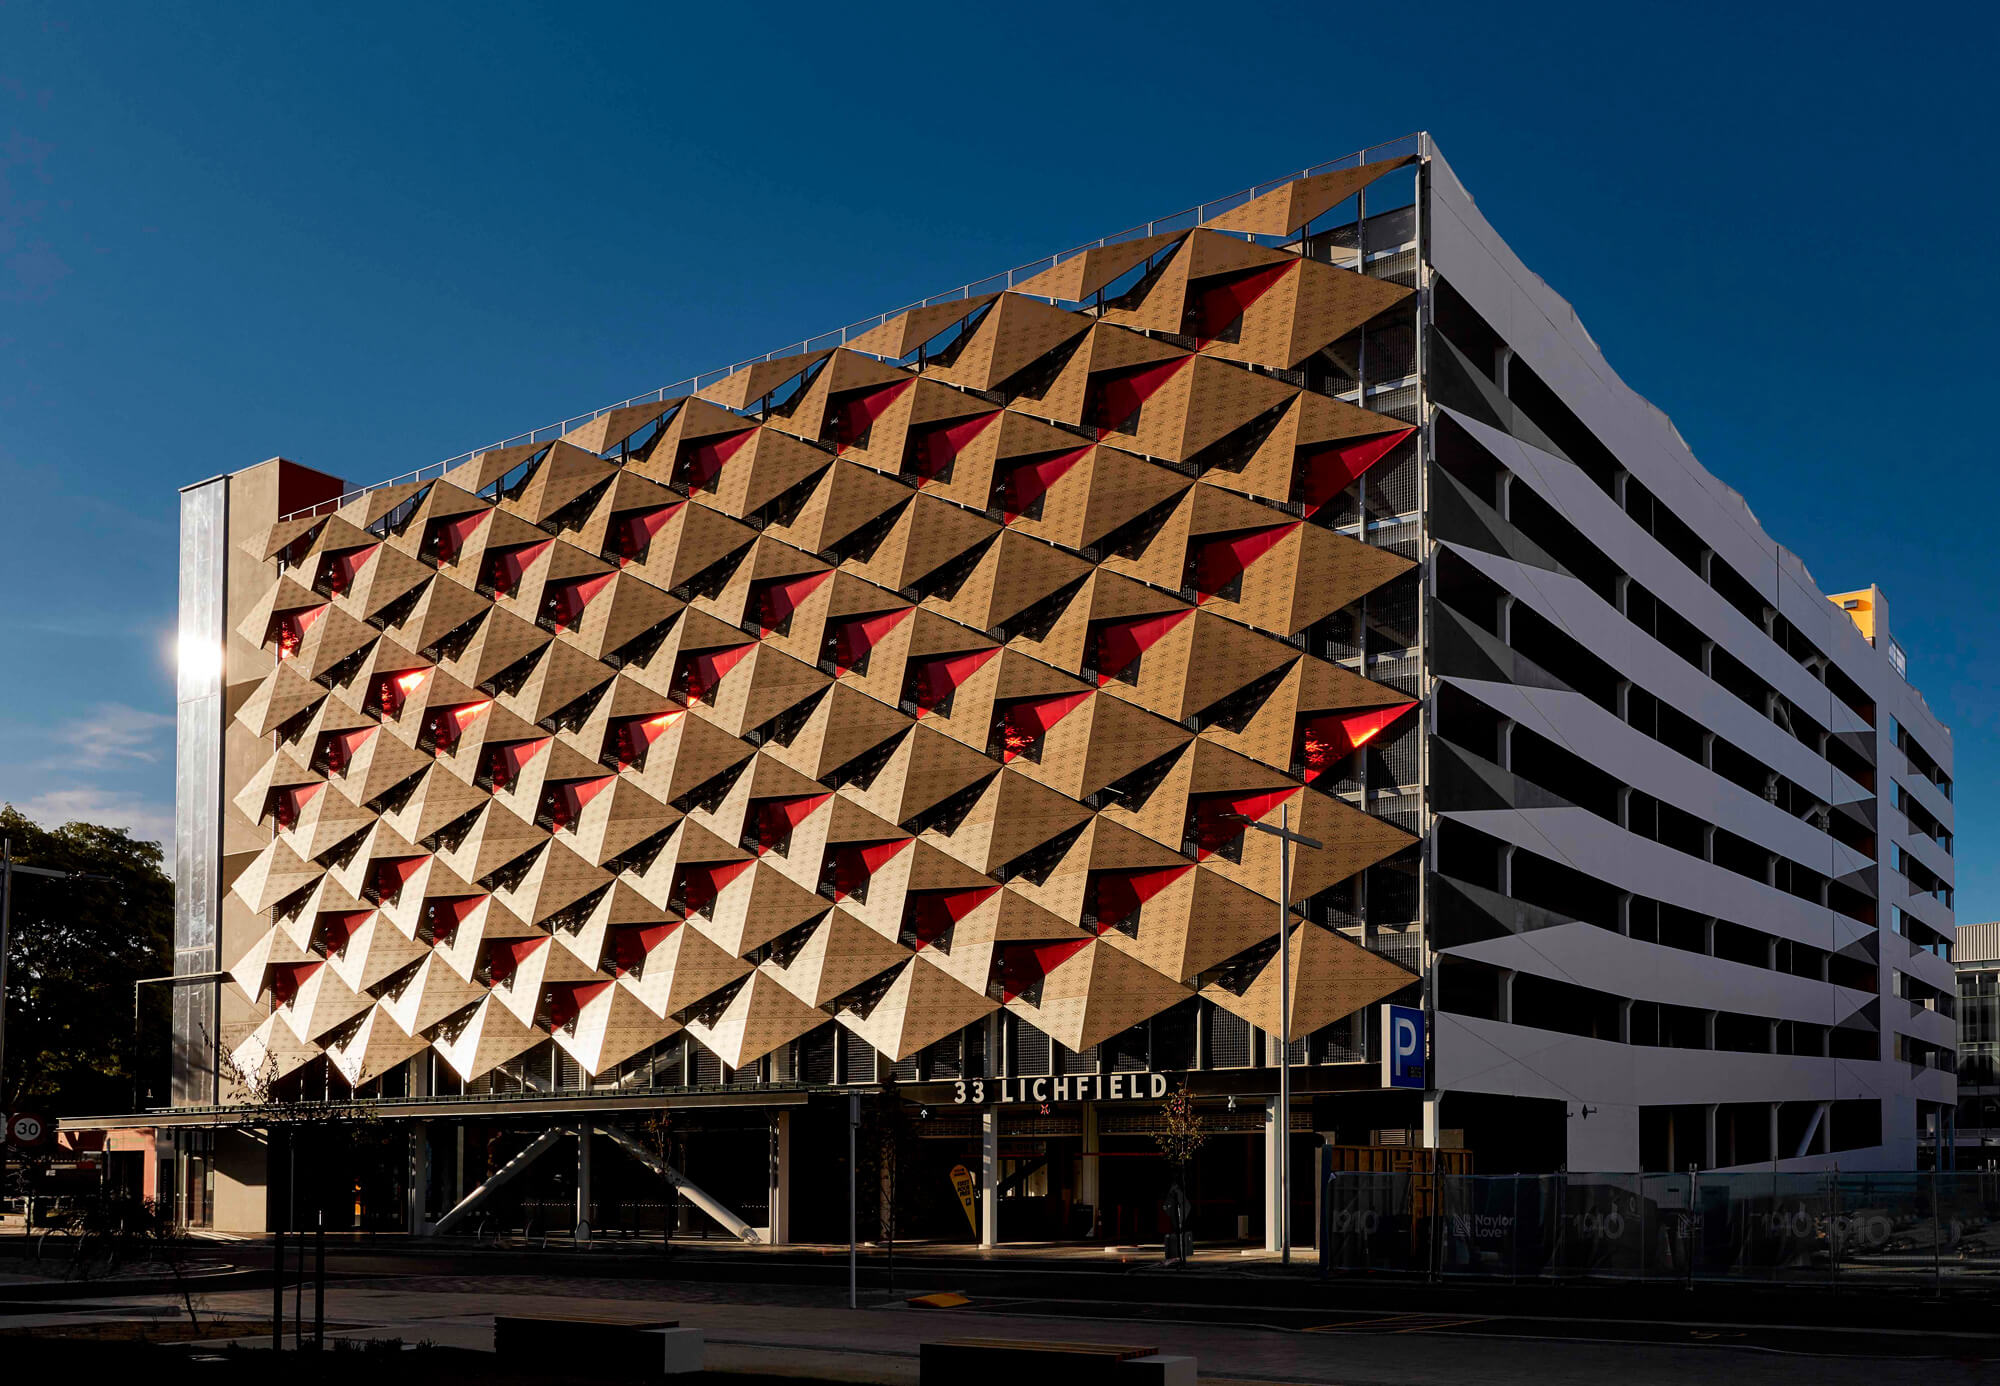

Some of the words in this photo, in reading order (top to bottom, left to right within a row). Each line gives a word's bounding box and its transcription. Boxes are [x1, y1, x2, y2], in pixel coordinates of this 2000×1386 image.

[1395, 1017, 1416, 1076] P
[953, 1081, 985, 1104] 33
[1001, 1074, 1168, 1103] LICHFIELD
[18, 1122, 38, 1135] 30
[1474, 1214, 1514, 1229] Naylor
